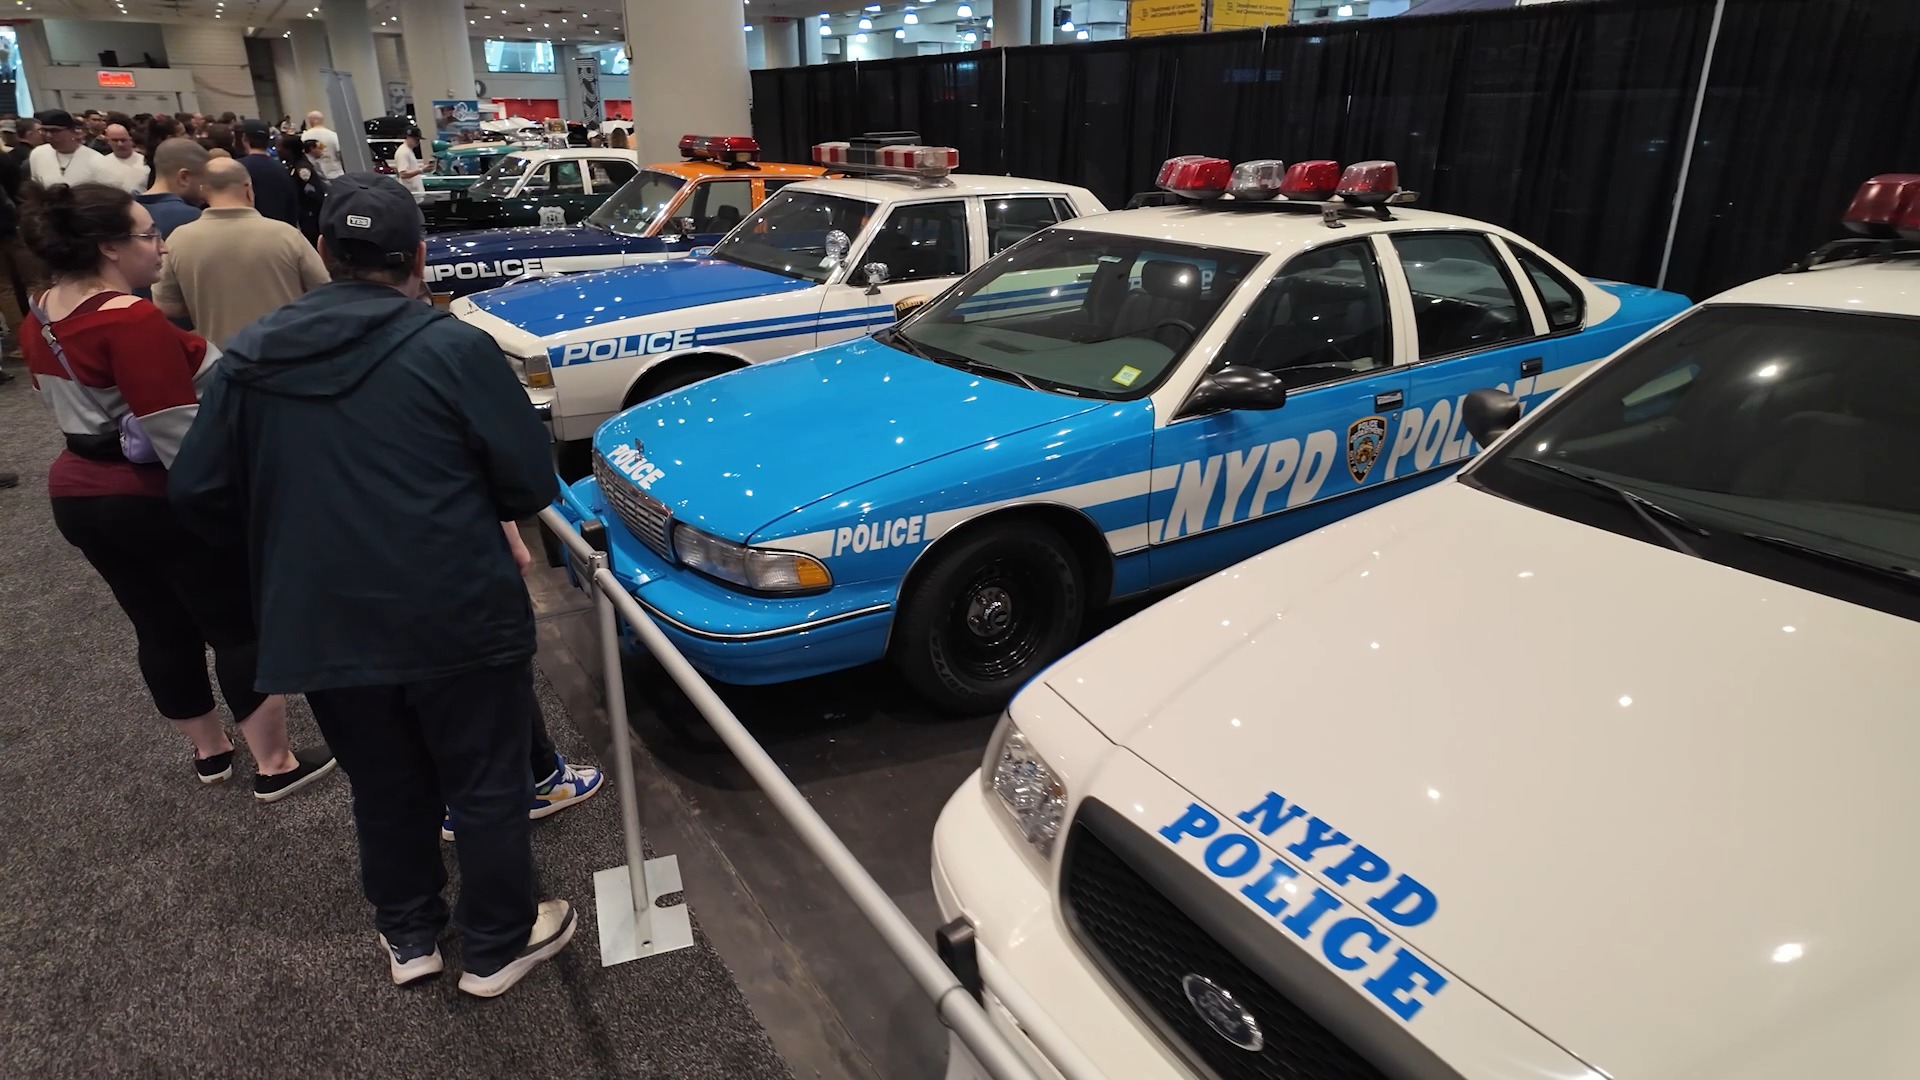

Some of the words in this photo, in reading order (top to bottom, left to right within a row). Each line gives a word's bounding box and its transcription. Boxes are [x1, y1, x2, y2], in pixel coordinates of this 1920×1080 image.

[435, 258, 544, 281] POLICE
[562, 328, 696, 366] POLICE
[1384, 377, 1535, 480] POL
[607, 443, 666, 490] POLICE
[1164, 429, 1337, 541] NYPD
[835, 515, 923, 556] POLICE
[1236, 791, 1438, 927] NYPD
[1158, 803, 1448, 1022] POLICE
